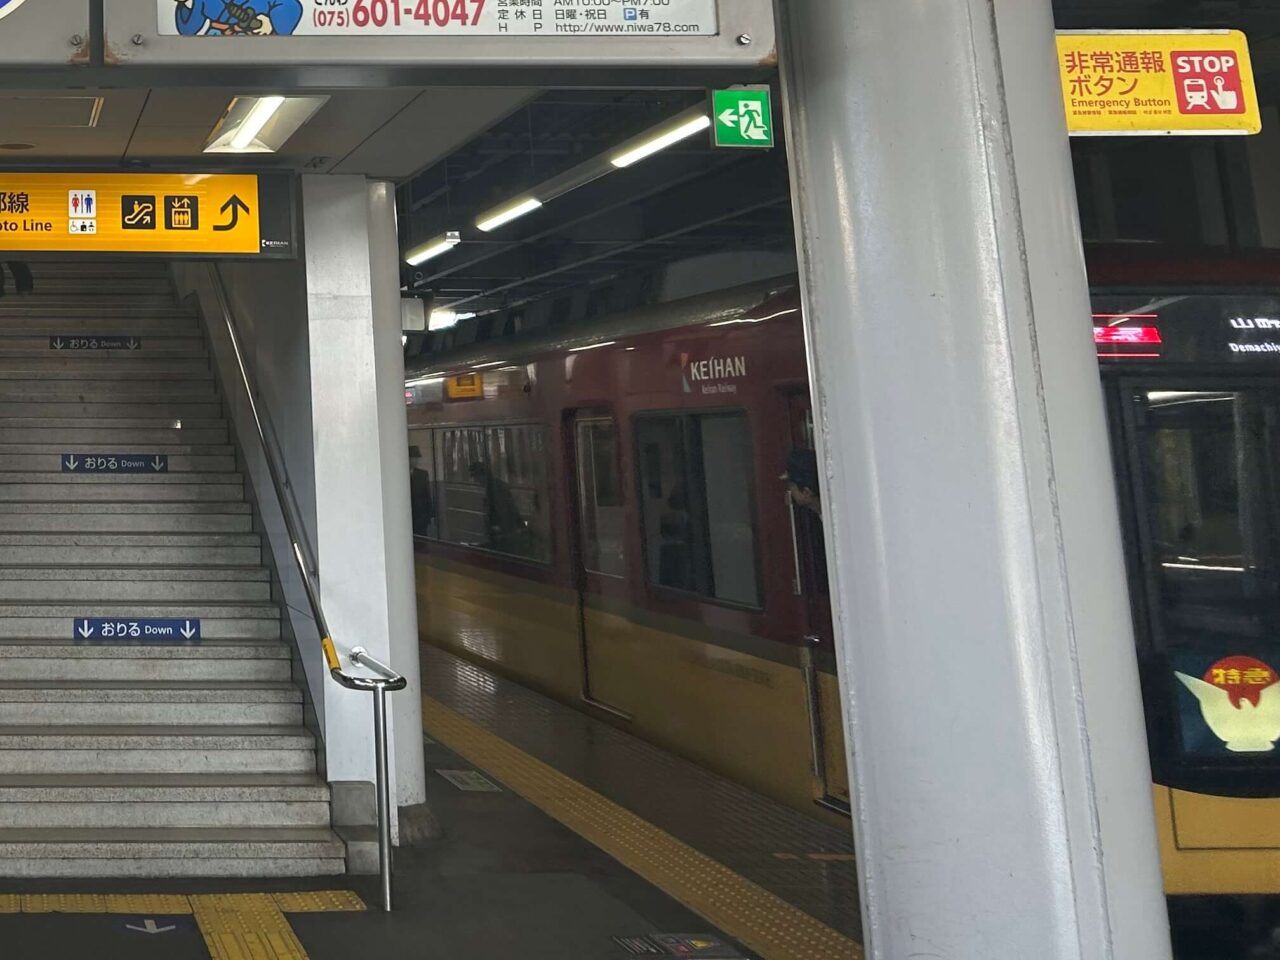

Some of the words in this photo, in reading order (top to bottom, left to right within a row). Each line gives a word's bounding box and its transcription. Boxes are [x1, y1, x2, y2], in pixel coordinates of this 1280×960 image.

[313, 8, 350, 28] (075)
[555, 23, 700, 34] http://www.niwa78.com
[1064, 50, 1166, 74] 非常通報
[1176, 56, 1235, 73] STOP
[1069, 74, 1138, 97] ボタン
[1071, 98, 1130, 109] Emergency
[1134, 98, 1171, 107] Button
[23, 219, 53, 232] Line
[70, 339, 98, 348] おりる
[690, 356, 746, 381] KEIHAN
[85, 457, 118, 470] おりる
[121, 459, 145, 468] Down
[101, 622, 140, 637] おりる
[144, 625, 173, 635] Down
